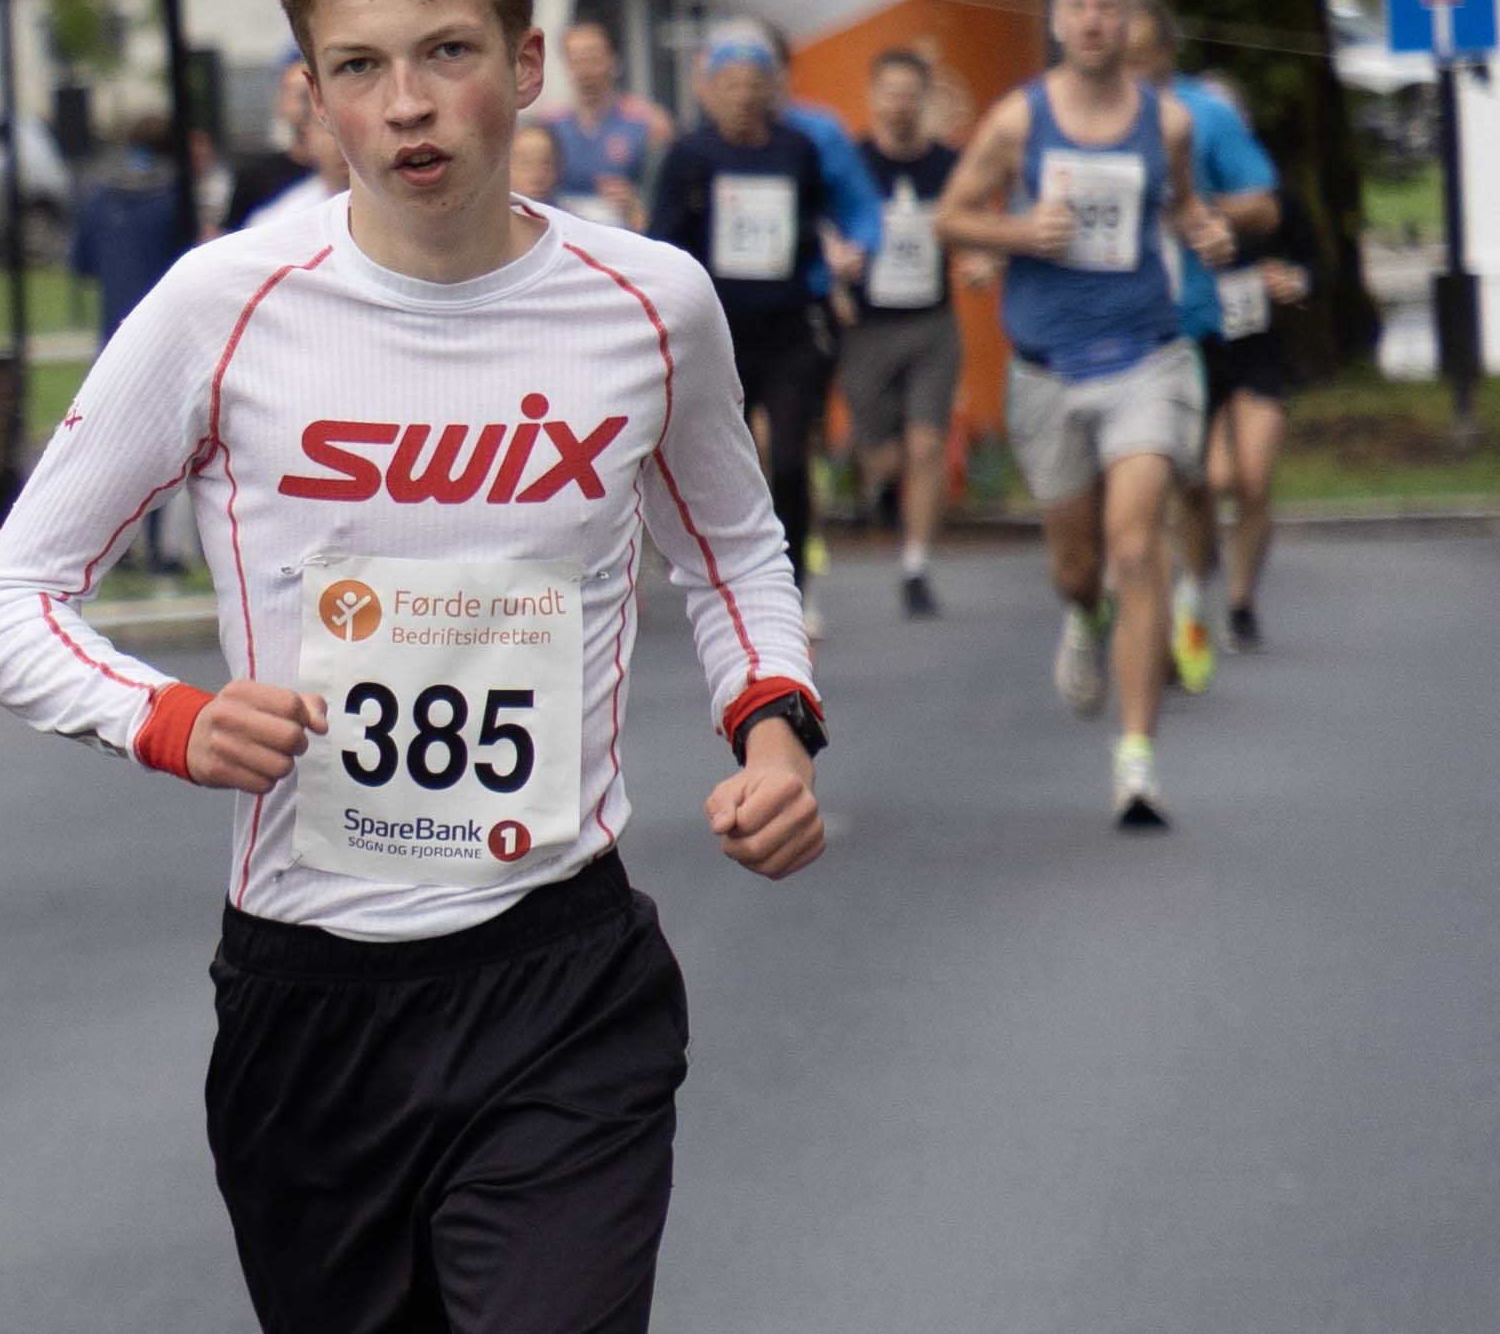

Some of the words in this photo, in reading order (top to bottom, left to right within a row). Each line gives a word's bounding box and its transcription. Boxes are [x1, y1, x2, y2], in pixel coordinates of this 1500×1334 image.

[394, 590, 481, 618] Førde
[490, 587, 567, 617] rundt
[391, 626, 552, 646] Bedriftsidretten
[341, 681, 535, 794] 385
[344, 808, 483, 843] SpareBank
[348, 835, 384, 854] SOGN
[387, 842, 407, 856] OG
[411, 845, 484, 860] FJORDANE
